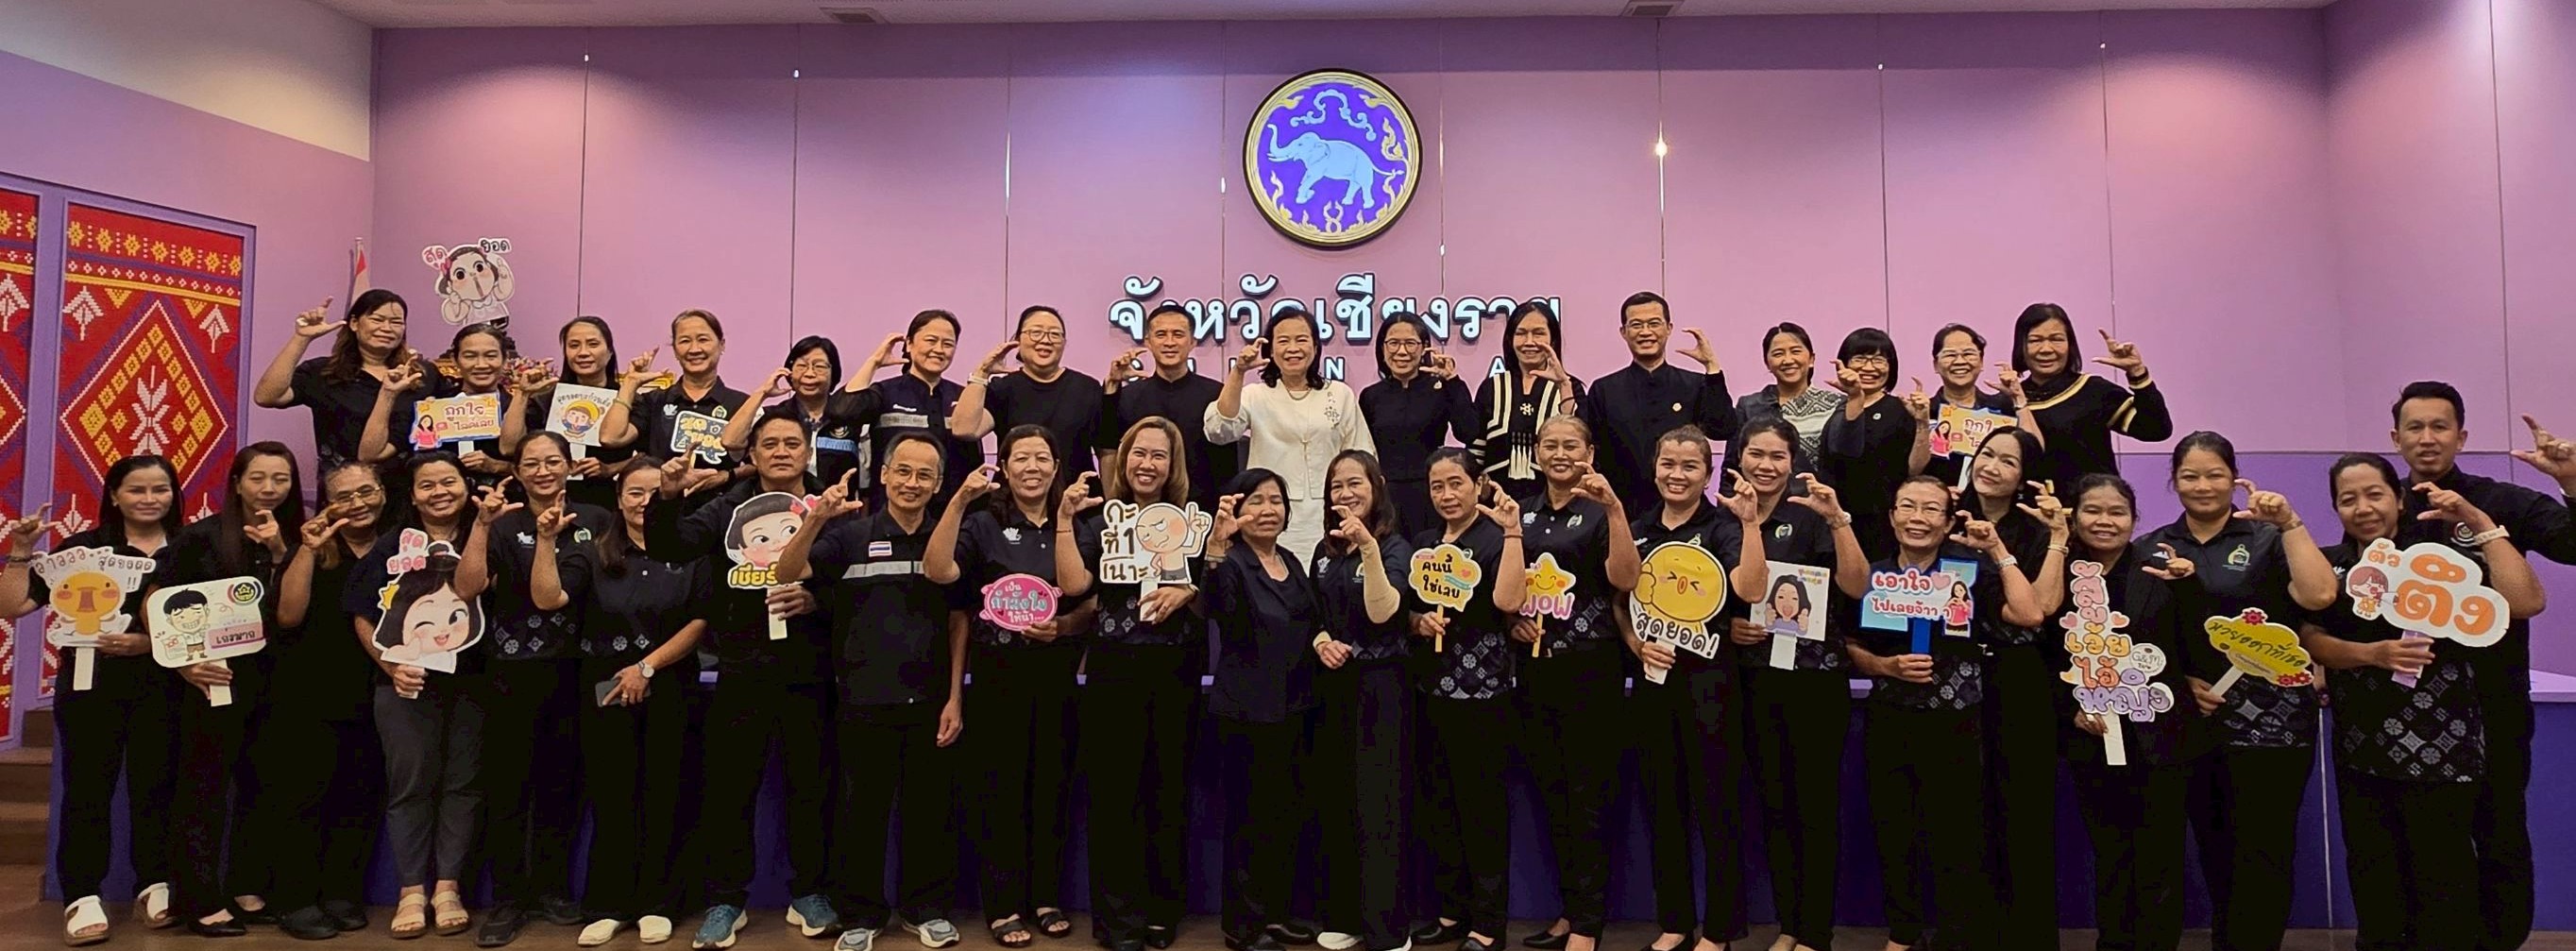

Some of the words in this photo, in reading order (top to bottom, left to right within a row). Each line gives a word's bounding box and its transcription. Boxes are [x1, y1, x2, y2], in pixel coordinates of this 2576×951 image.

[480, 239, 510, 253] ยอด
[445, 402, 485, 421] ถูกใจ
[1107, 502, 1137, 523] กะ
[401, 531, 424, 552] สุด
[388, 555, 426, 572] ยอด
[1422, 553, 1452, 573] คนนี้
[2368, 542, 2400, 568] ตัว
[1103, 563, 1148, 581] เนาะ
[1874, 570, 1931, 591] เอาใจ
[1422, 574, 1460, 598] ใช่เลย
[2394, 553, 2496, 636] ตึง
[991, 589, 1047, 612] กำลังใจ
[1520, 594, 1572, 617] WOW
[1636, 613, 1718, 656] สุดยอด!
